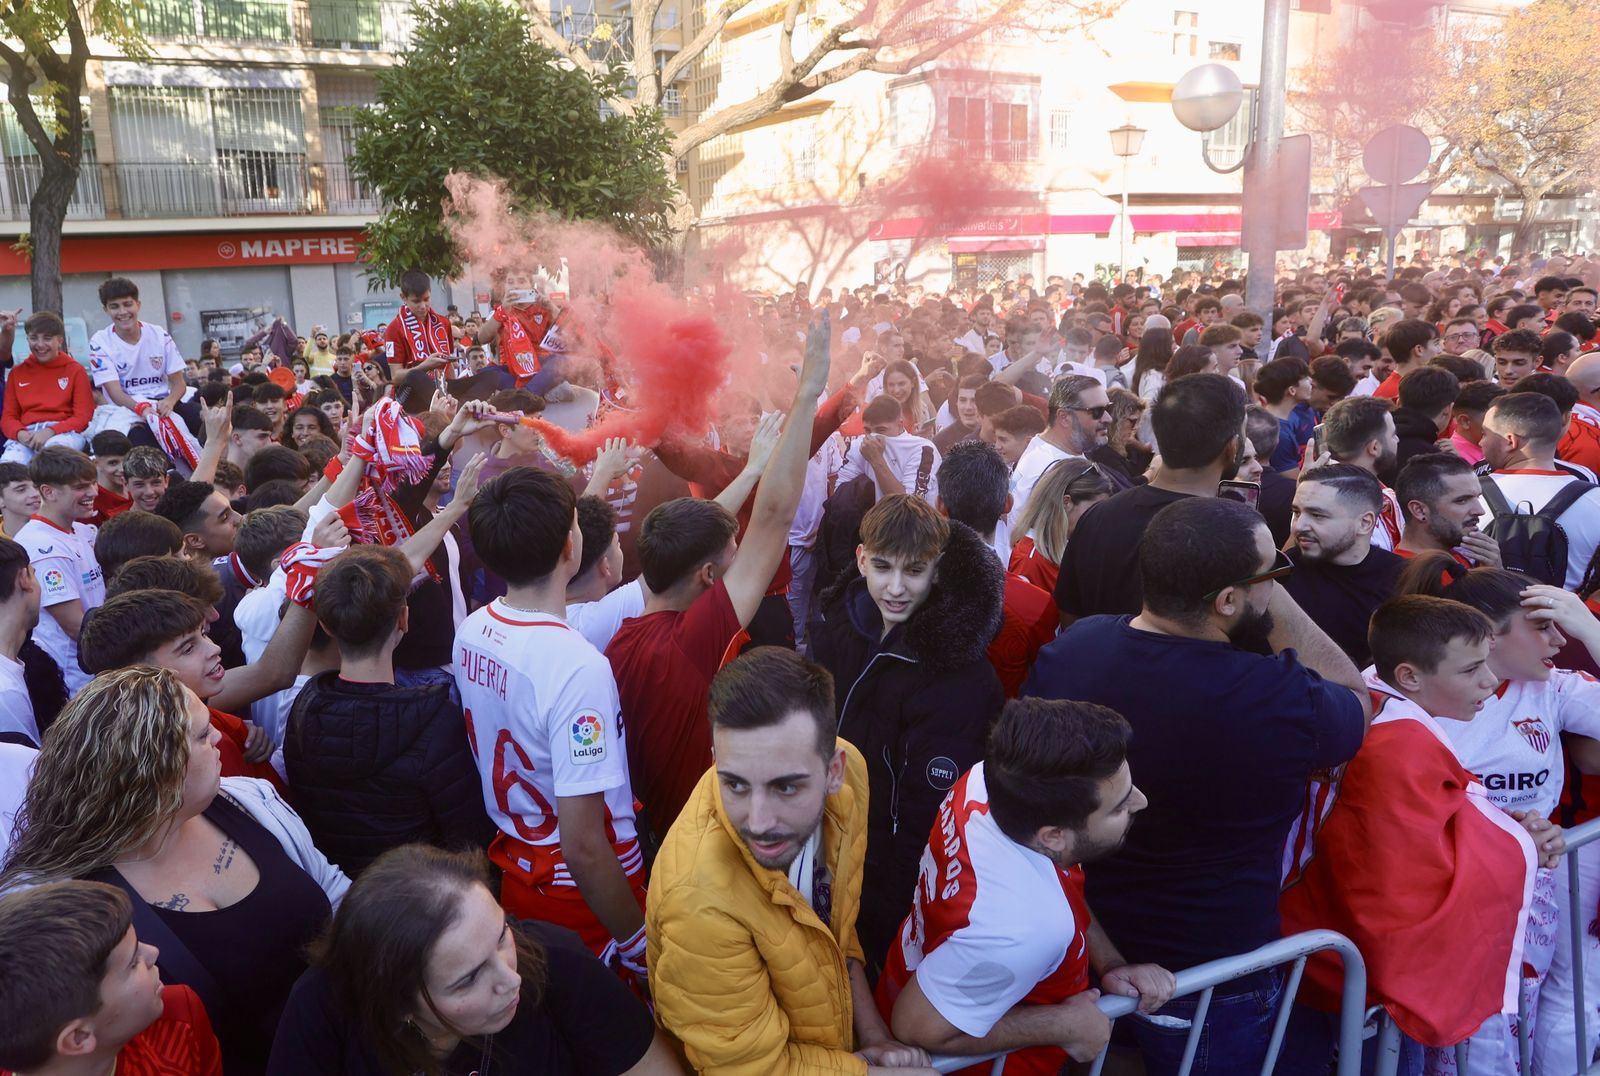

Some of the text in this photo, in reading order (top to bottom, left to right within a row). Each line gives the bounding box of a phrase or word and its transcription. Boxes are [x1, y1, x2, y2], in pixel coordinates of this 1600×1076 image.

[240, 237, 355, 259] MAPFRE
[461, 647, 508, 701] PUERTA
[573, 746, 603, 758] LaLiga
[930, 766, 954, 780] SUPPLY
